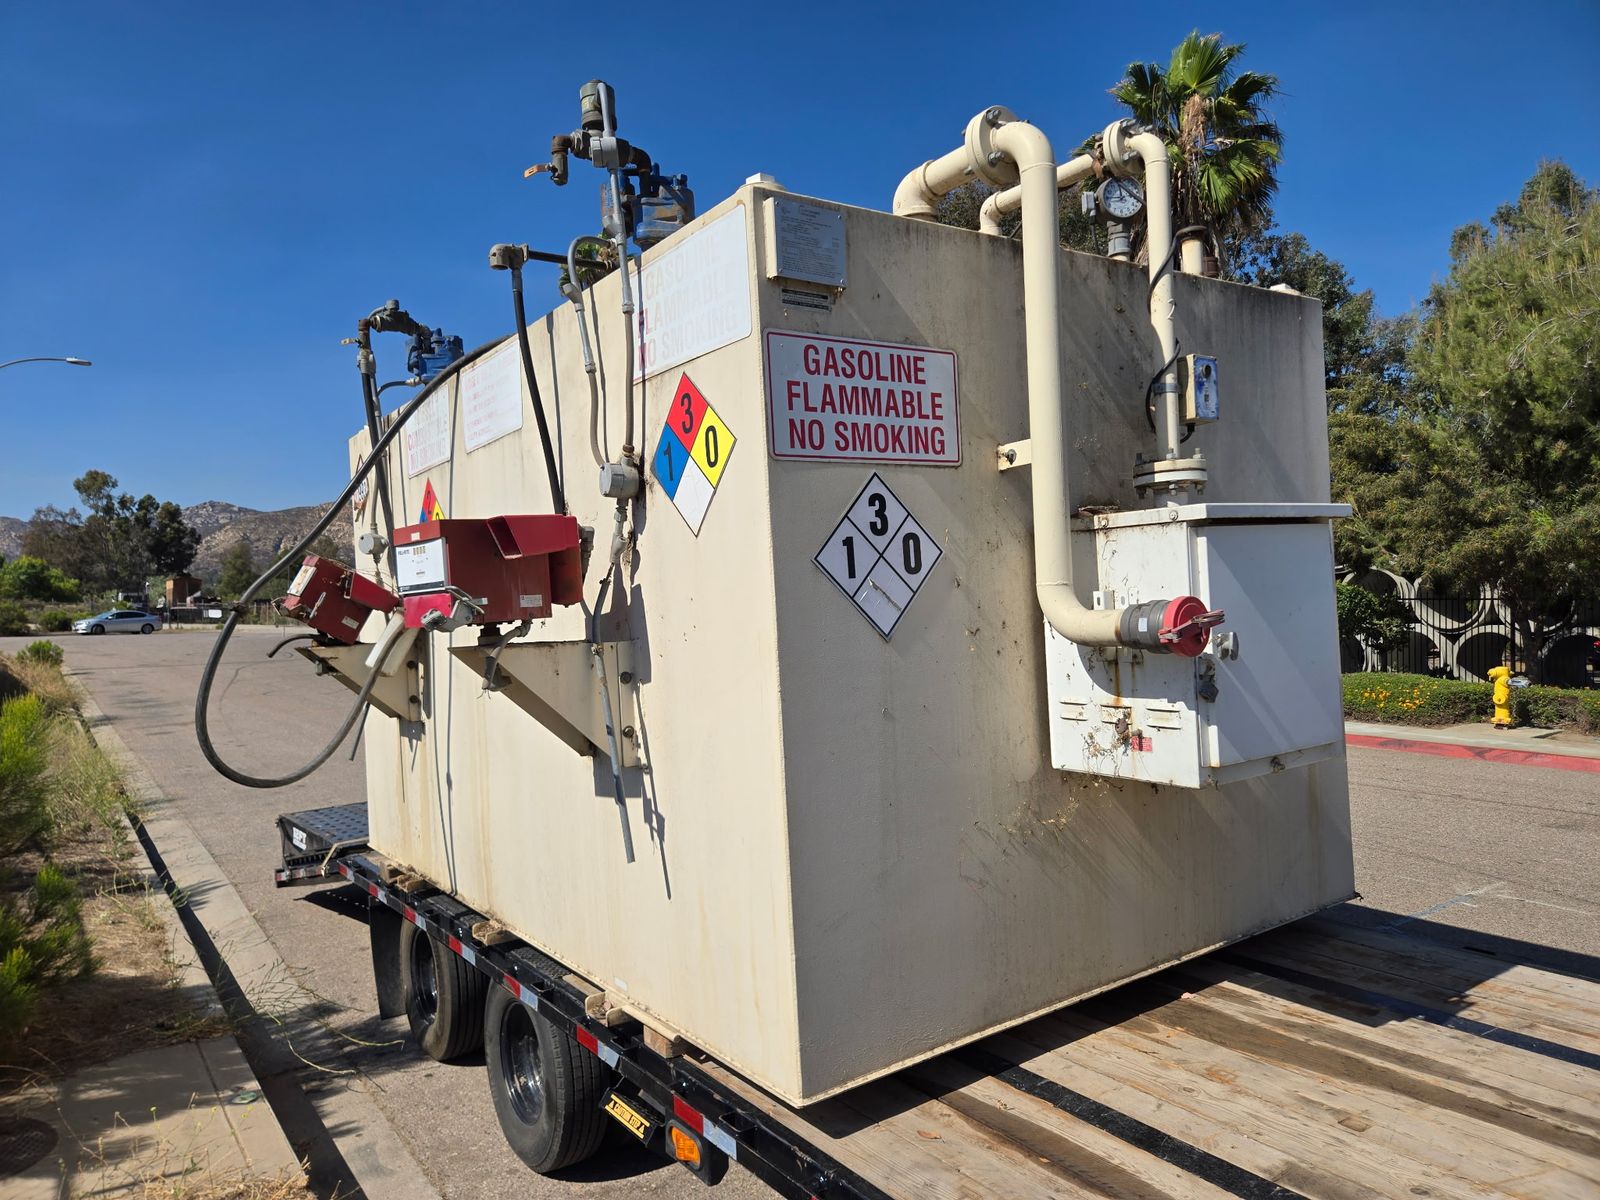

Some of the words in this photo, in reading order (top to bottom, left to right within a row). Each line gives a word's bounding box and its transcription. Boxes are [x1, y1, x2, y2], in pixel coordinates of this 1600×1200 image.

[662, 302, 738, 361] SMOKING
[802, 344, 926, 385] GASOLINE
[680, 392, 694, 434] 3
[786, 380, 944, 421] FLAMMABLE
[663, 440, 674, 482] 1
[704, 425, 719, 469] 0
[788, 418, 825, 451] NO
[834, 421, 946, 456] SMOKING
[426, 490, 432, 515] 2
[868, 492, 890, 537] 3
[841, 535, 857, 580] 1
[902, 531, 923, 576] 0
[629, 1115, 641, 1129] STEP
